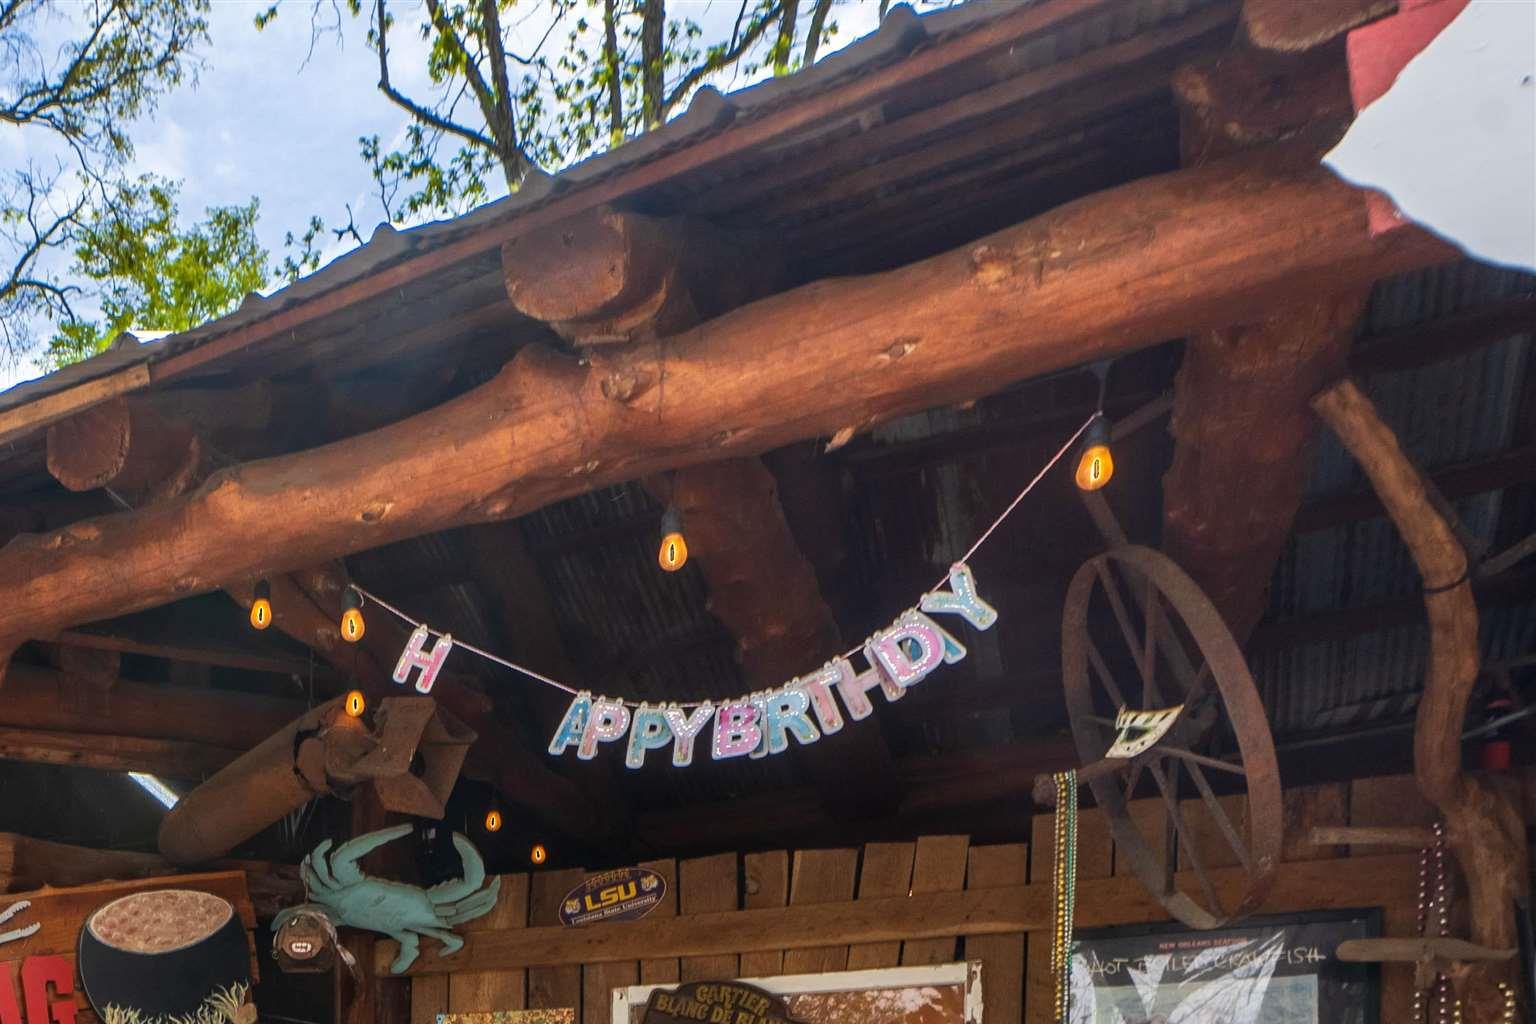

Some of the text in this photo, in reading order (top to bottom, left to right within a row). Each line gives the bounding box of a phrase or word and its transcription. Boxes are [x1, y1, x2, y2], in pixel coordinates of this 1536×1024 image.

[392, 626, 453, 694] H
[584, 881, 637, 911] LSU
[622, 895, 658, 911] University
[1214, 936, 1249, 947] SEAF
[655, 995, 709, 1021] BLANC
